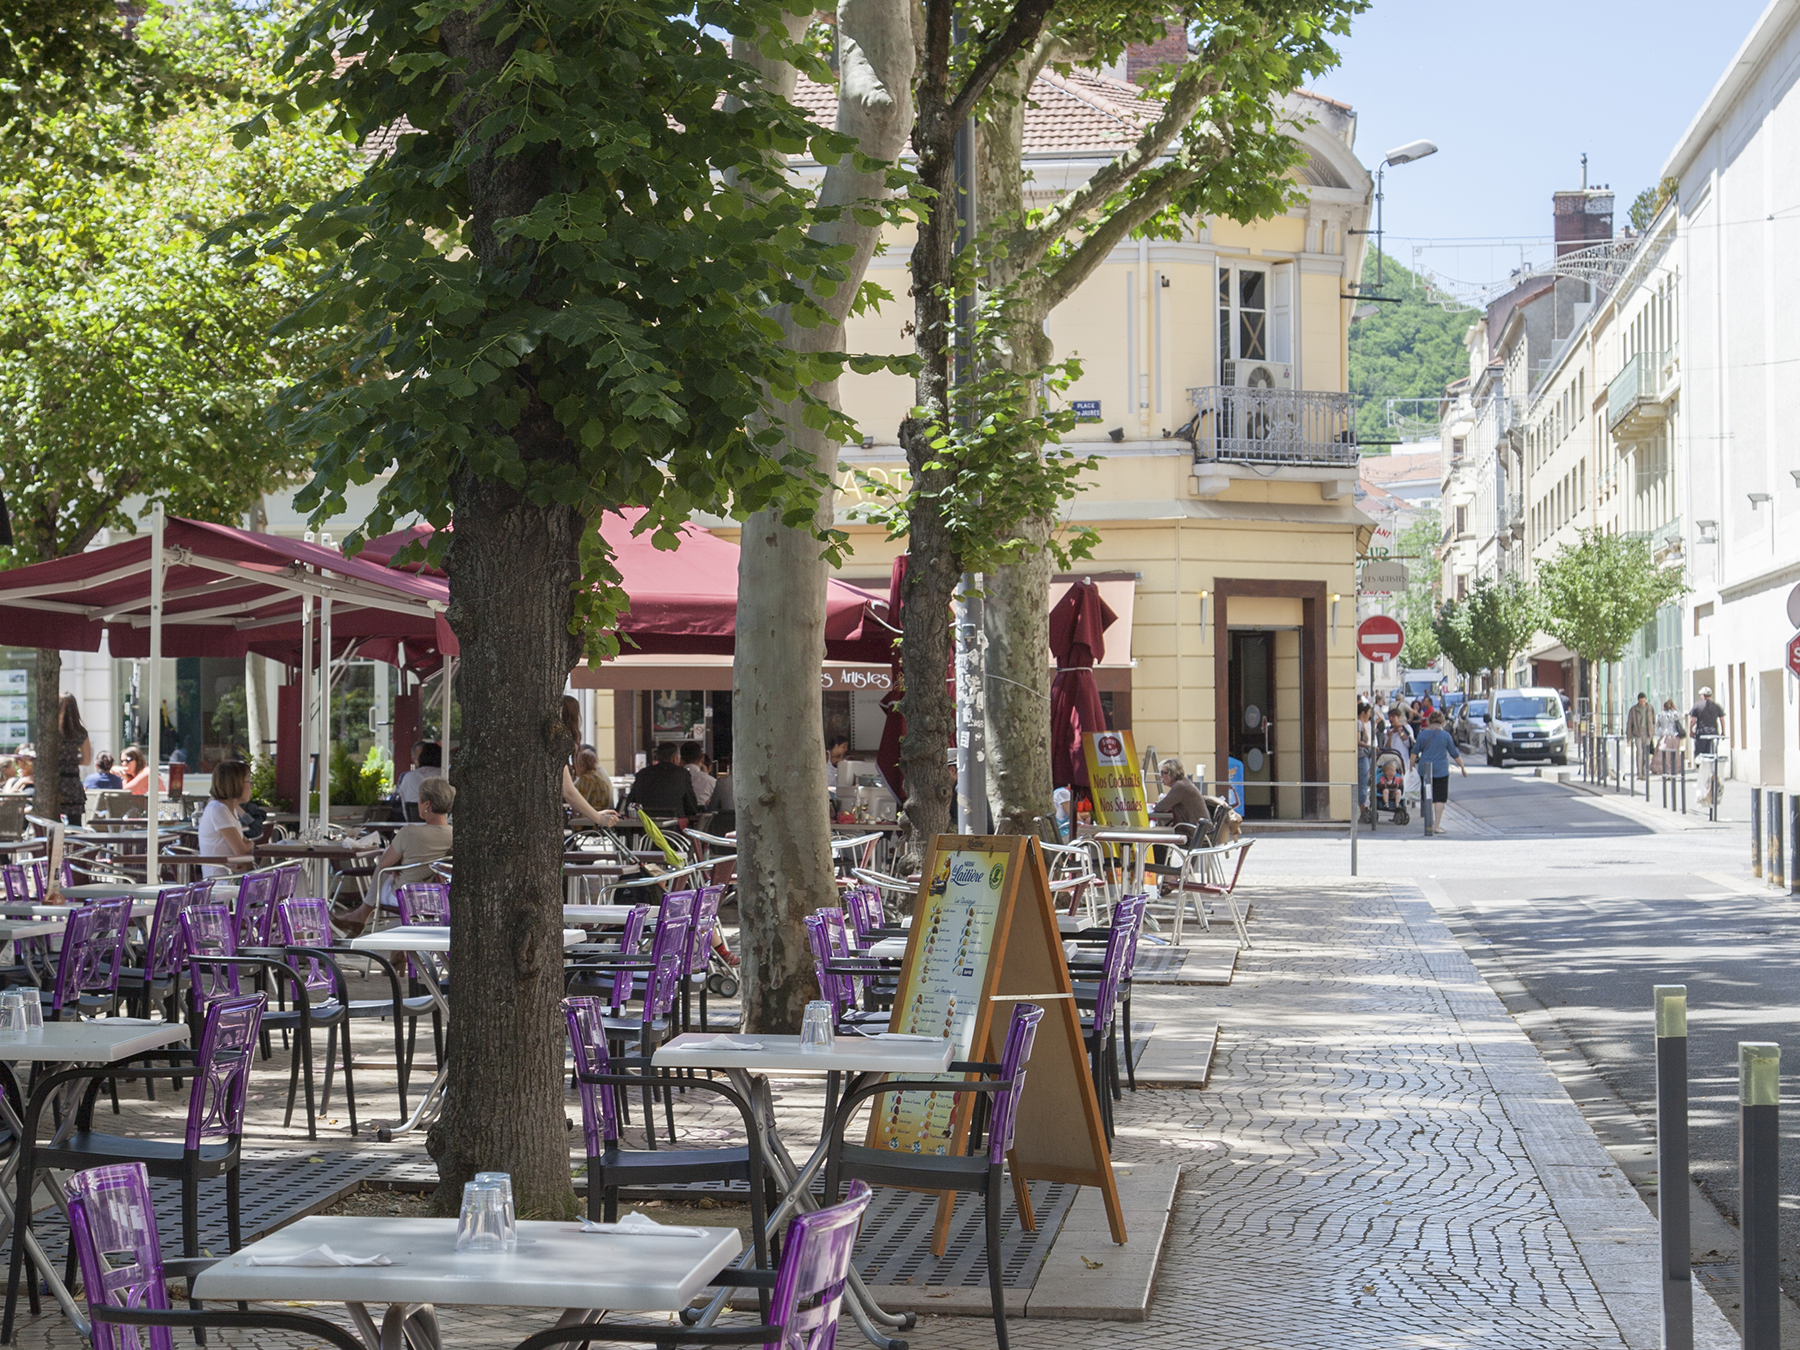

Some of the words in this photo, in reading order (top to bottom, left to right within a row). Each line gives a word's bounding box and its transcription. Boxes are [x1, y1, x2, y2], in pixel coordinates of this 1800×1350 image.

[1373, 527, 1392, 539] ANT
[1364, 575, 1376, 583] LES
[1377, 575, 1407, 583] ARTISTES
[840, 669, 891, 689] Artistes
[1093, 774, 1107, 788] Nos
[1108, 773, 1141, 788] Cocktails
[1099, 797, 1114, 812] Nos
[1115, 797, 1143, 812] Salades
[950, 864, 985, 887] Laitière
